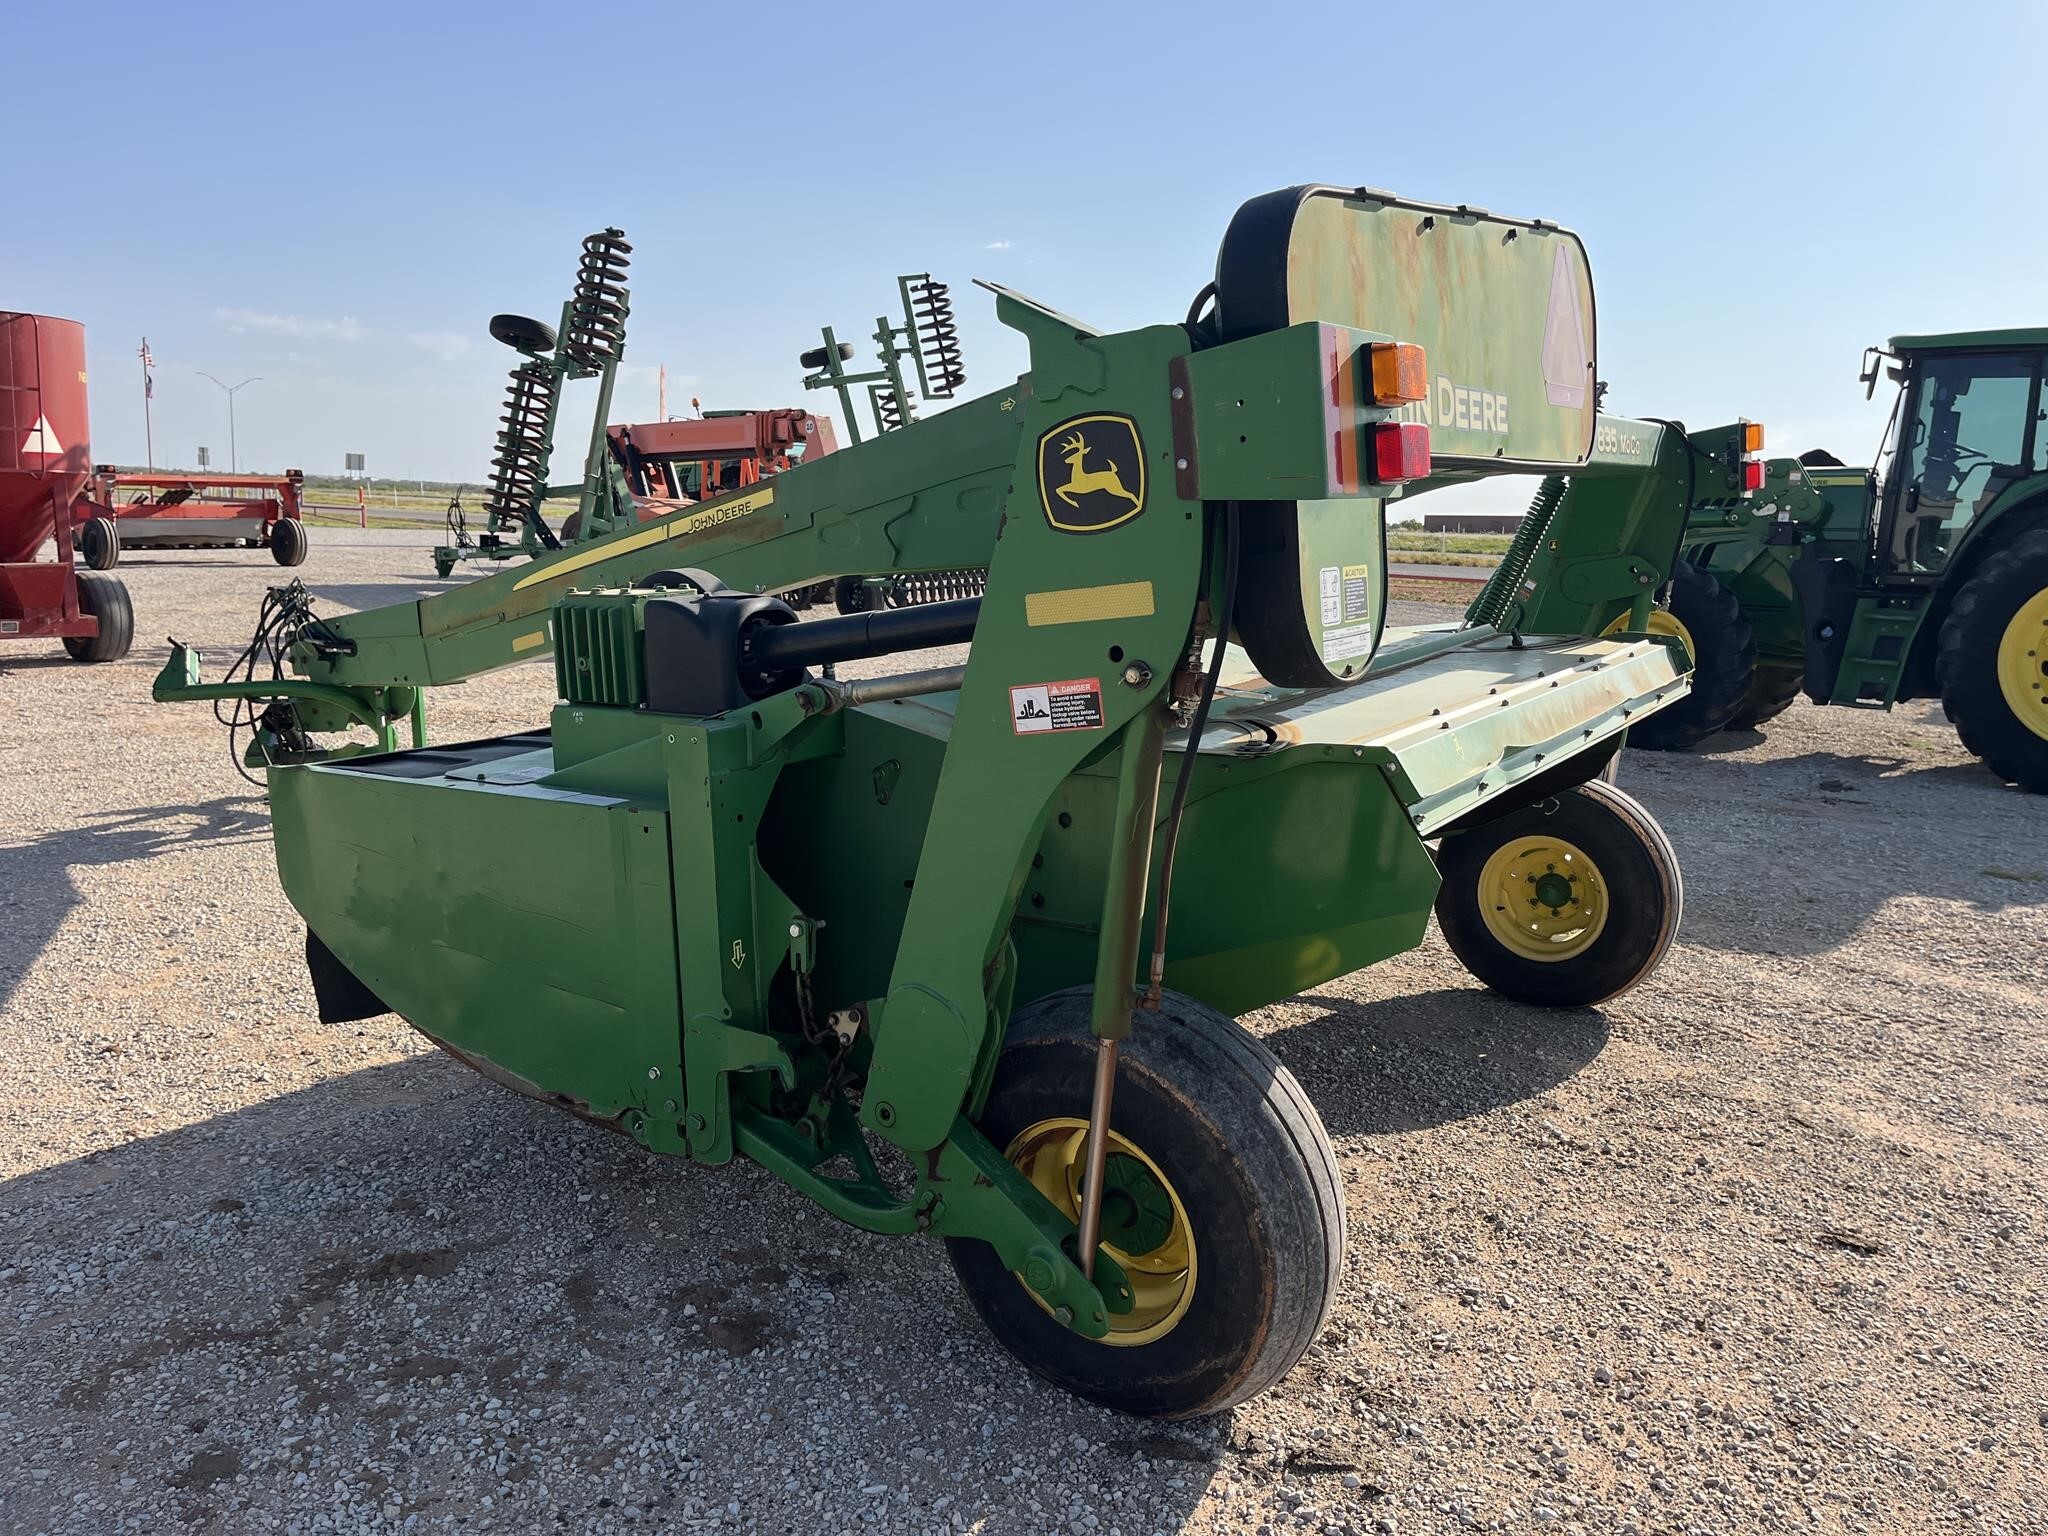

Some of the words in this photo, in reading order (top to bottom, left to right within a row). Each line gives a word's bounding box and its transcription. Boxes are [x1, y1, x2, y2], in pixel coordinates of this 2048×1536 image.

[1437, 375, 1508, 433] DEERE
[689, 513, 715, 532] JOHN
[716, 501, 752, 522] DEERE
[1061, 684, 1091, 693] DANGER
[1064, 705, 1085, 713] hydraulic
